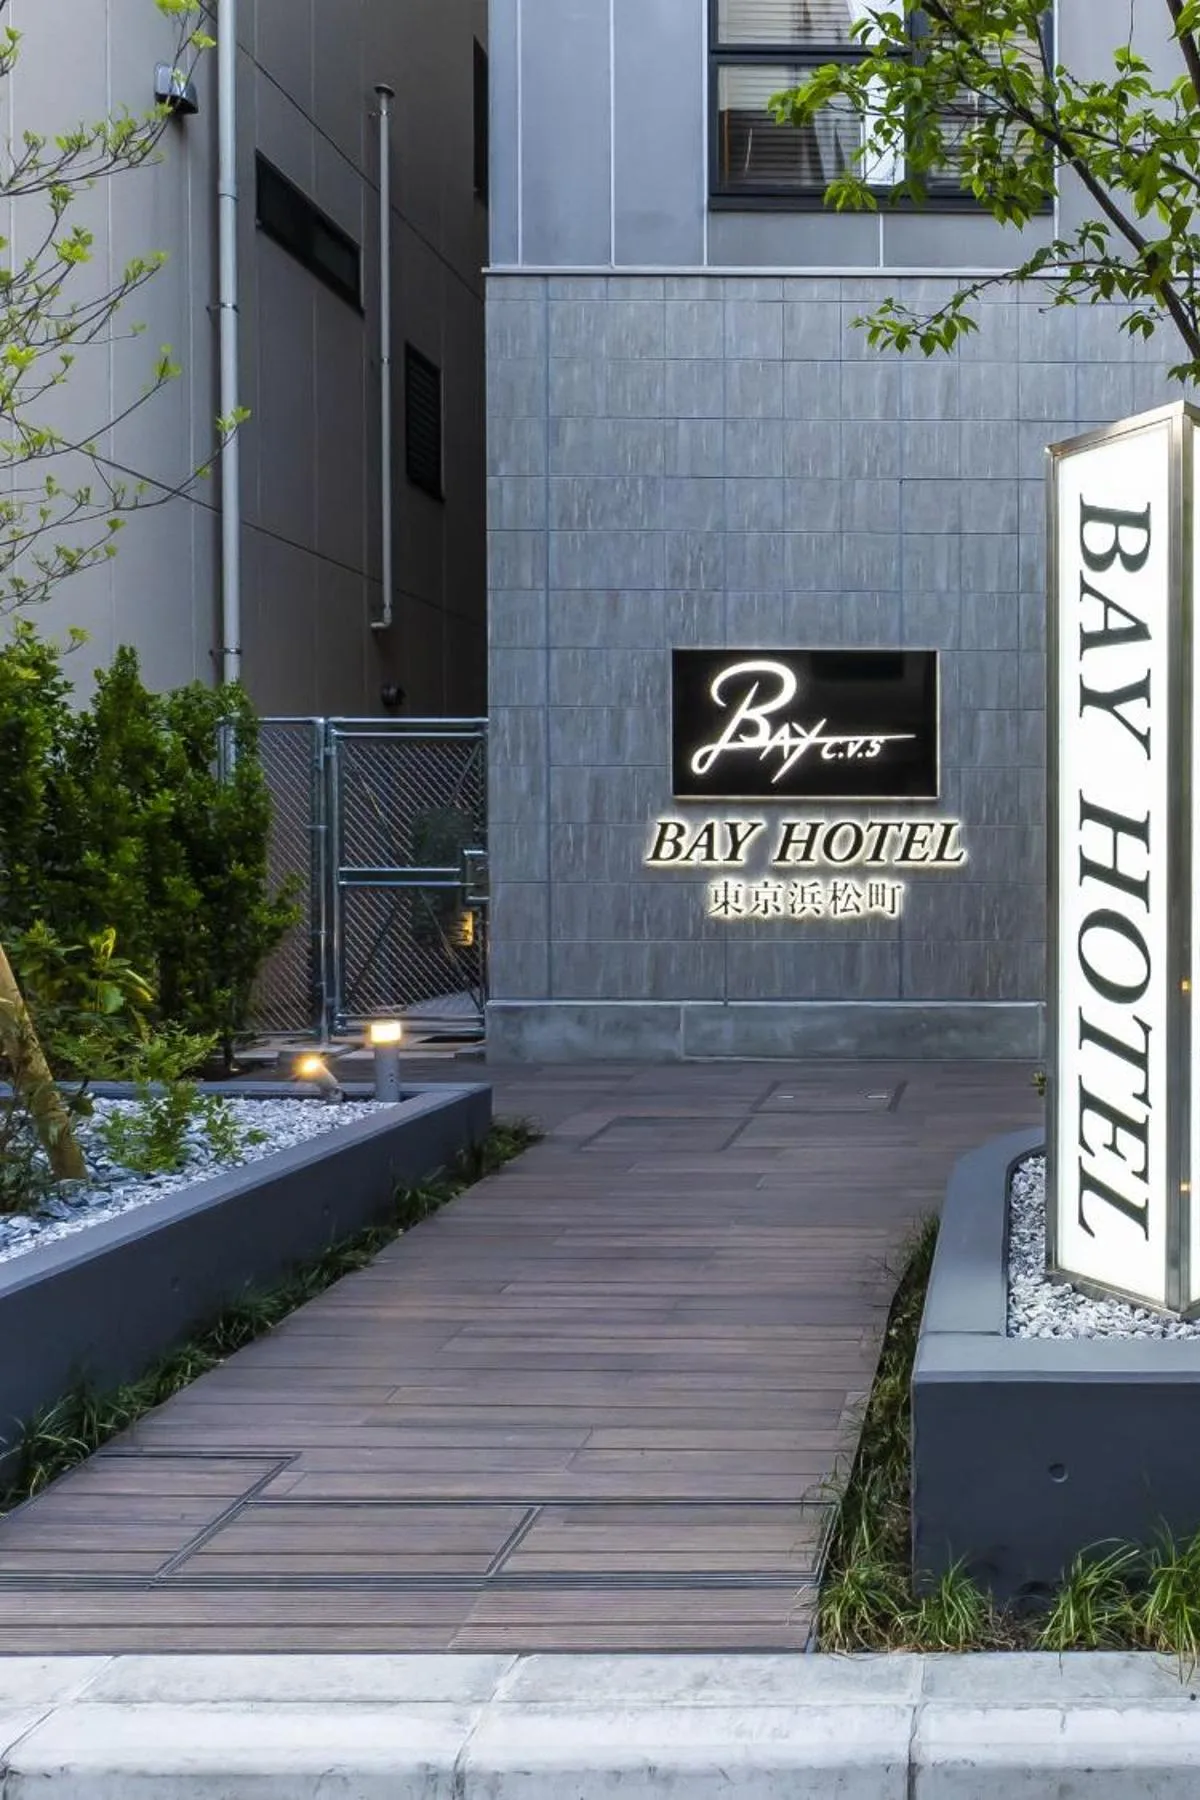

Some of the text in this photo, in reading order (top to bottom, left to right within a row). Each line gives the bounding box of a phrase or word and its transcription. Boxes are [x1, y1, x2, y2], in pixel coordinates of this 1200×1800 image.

[646, 820, 966, 863] BAY HOTEL
[1078, 493, 1152, 1241] BAY HOTEL
[707, 880, 903, 916] 東京浜松町
